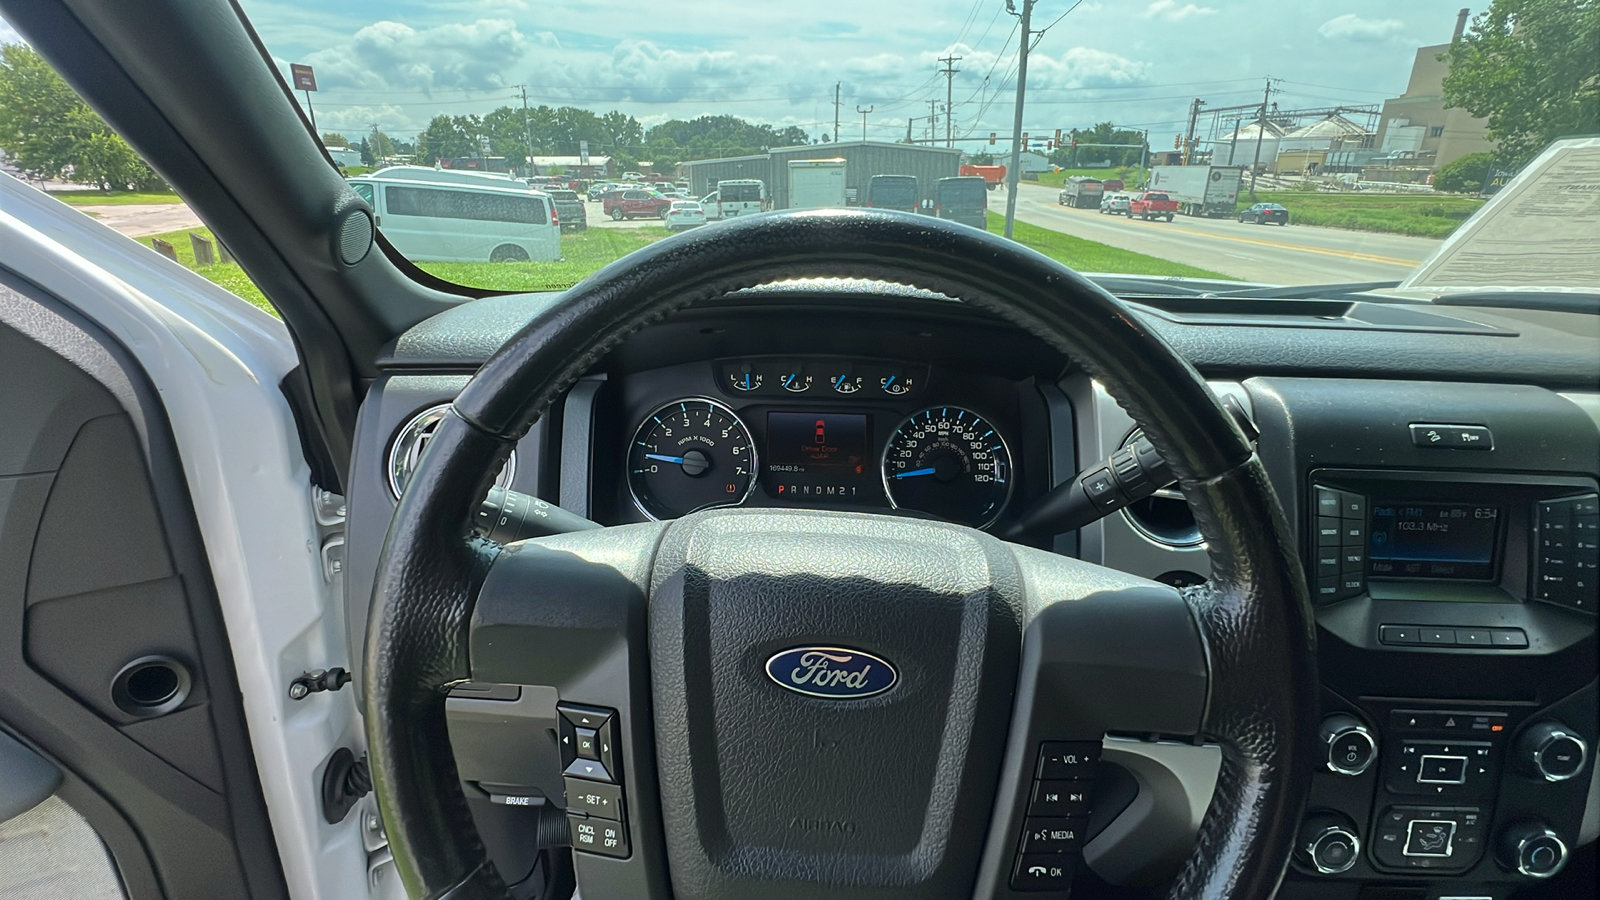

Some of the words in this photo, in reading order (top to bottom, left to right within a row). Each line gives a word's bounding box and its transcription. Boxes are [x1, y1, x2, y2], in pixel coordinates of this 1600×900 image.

[683, 419, 690, 427] 3
[704, 419, 711, 427] 4
[937, 422, 950, 430] 60
[665, 428, 672, 437] 2
[924, 425, 937, 433] 50
[952, 426, 964, 434] 70
[722, 430, 729, 438] 5
[912, 431, 925, 439] 40
[962, 433, 975, 441] 80
[678, 436, 692, 445] RPM
[700, 436, 715, 446] 1000
[906, 441, 918, 449] 30
[732, 446, 740, 455] 6
[650, 465, 658, 473] 0
[735, 467, 742, 475] 7
[977, 463, 990, 471] 110
[974, 474, 989, 482] 120
[778, 485, 785, 494] P
[791, 485, 797, 494] R
[803, 486, 810, 494] N
[816, 486, 822, 495] D
[826, 487, 835, 495] M
[839, 487, 846, 495] 2
[851, 487, 856, 495] 1
[791, 651, 872, 689] Ford
[1063, 755, 1078, 764] VOL
[505, 796, 529, 806] BRAKE
[586, 794, 601, 805] SET
[578, 824, 595, 835] CNCL
[605, 828, 616, 838] ON
[579, 834, 593, 844] RSM
[1050, 831, 1074, 839] MEDIA
[604, 837, 617, 848] OFF
[1050, 867, 1062, 877] OK
